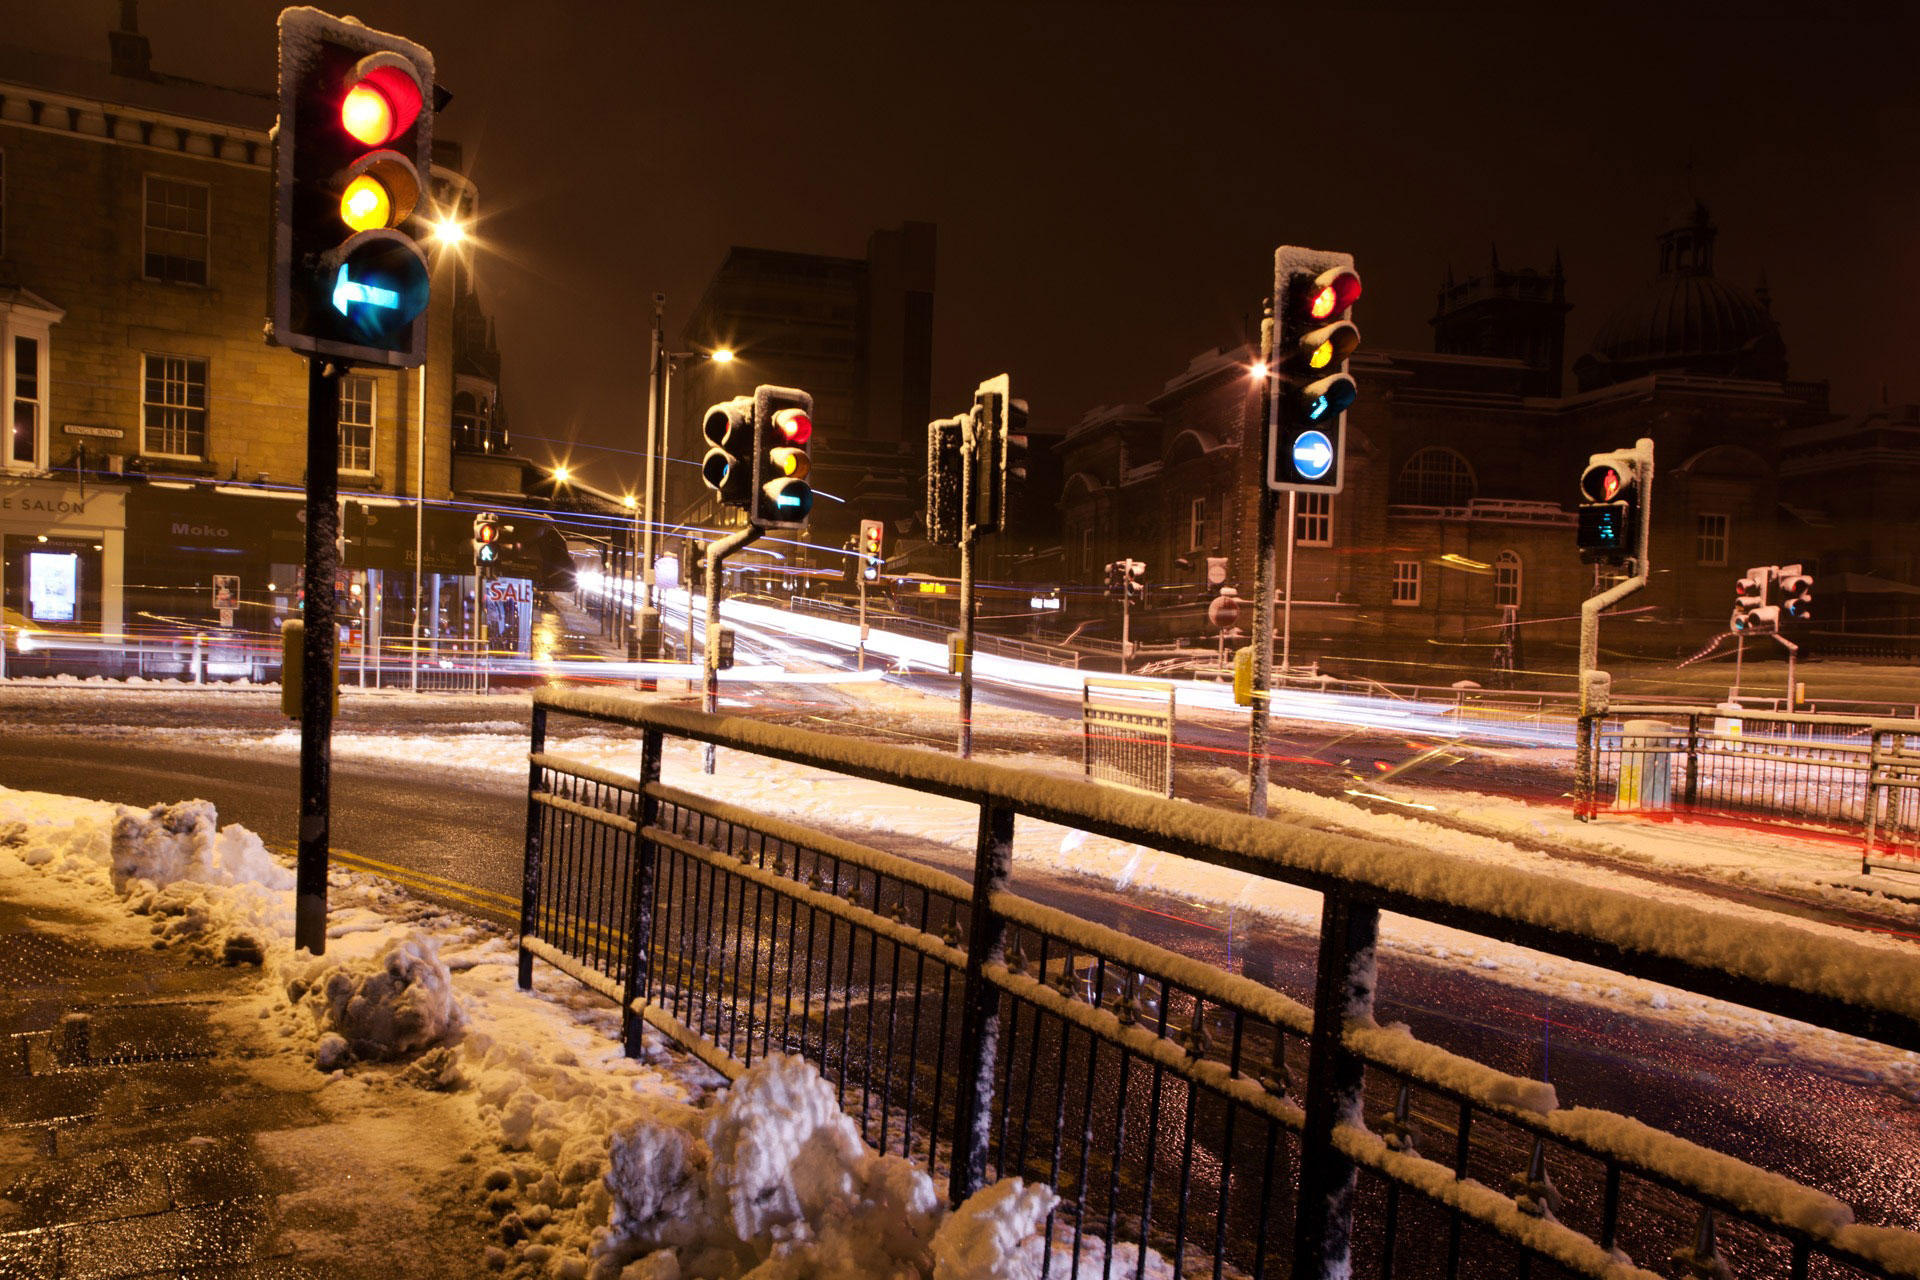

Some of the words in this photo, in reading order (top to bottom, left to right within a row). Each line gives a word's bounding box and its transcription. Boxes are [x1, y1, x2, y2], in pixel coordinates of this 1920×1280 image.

[22, 499, 85, 514] SALON
[172, 523, 229, 538] Moko
[490, 582, 530, 603] SALE
